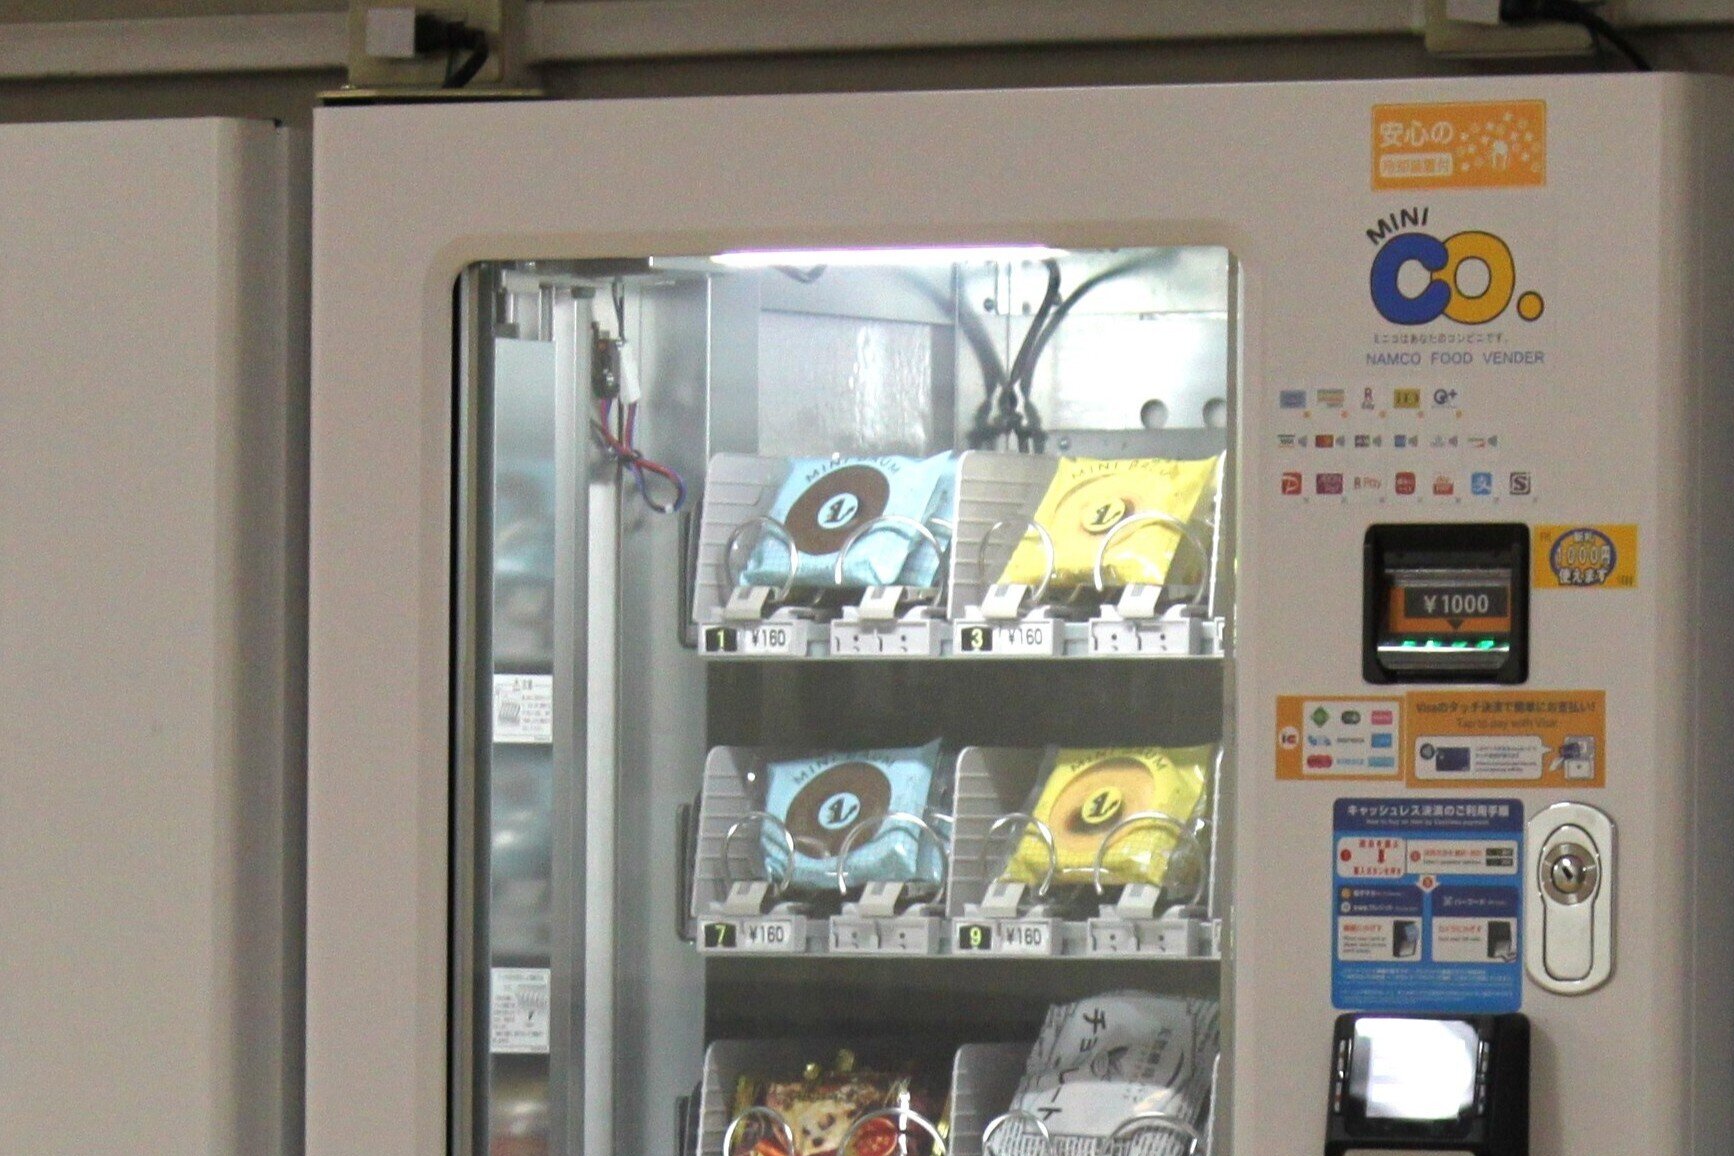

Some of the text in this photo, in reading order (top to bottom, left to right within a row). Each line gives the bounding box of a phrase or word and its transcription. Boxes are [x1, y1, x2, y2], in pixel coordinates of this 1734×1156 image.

[1380, 120, 1454, 147] 安心の
[1365, 206, 1430, 246] MINI
[1365, 351, 1545, 366] NAMCO FOOD VENDER
[1424, 593, 1489, 615] ¥1000
[751, 628, 786, 647] ¥160
[970, 627, 1043, 649] 3 ¥160
[714, 924, 784, 945] 7 ¥160
[969, 926, 1042, 948] 9 ¥160
